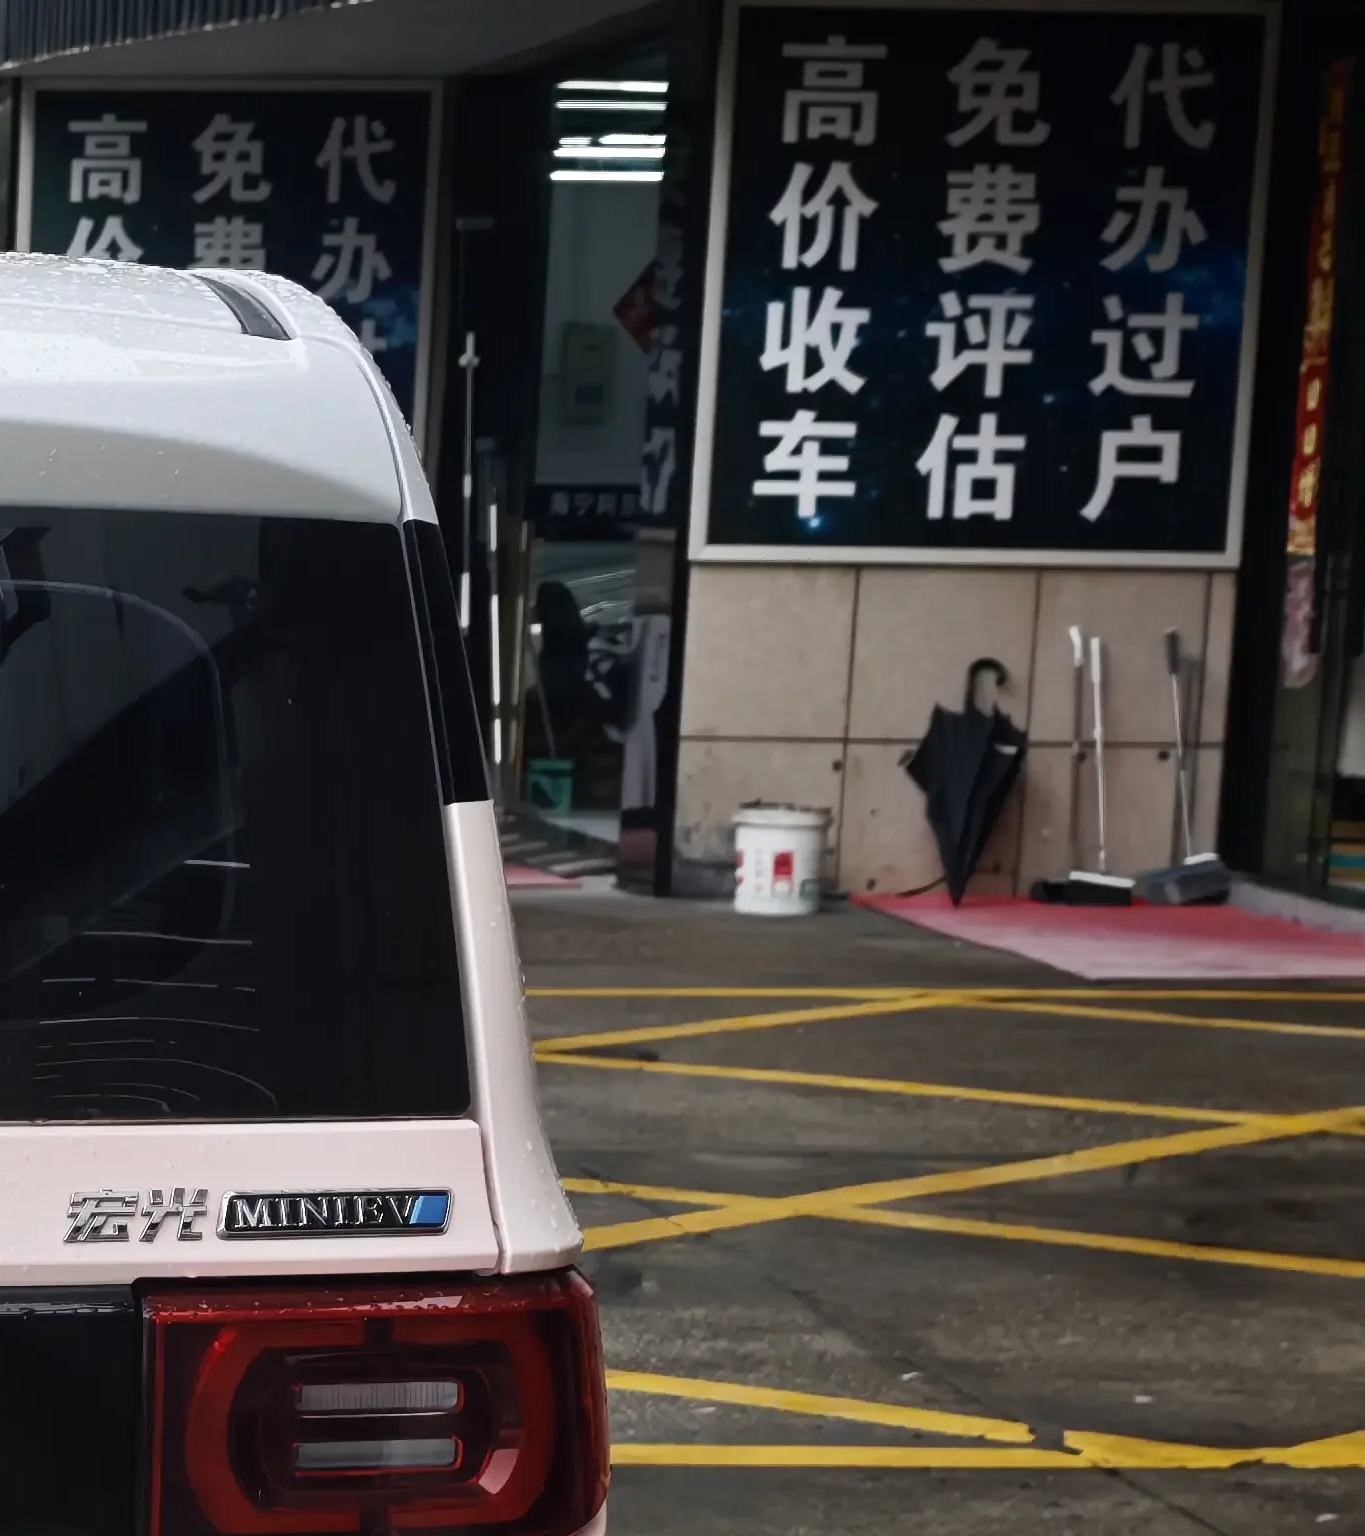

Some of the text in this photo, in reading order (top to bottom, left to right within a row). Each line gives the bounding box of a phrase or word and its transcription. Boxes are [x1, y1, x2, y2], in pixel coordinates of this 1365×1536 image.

[752, 35, 888, 519] 高价收车
[915, 37, 1051, 522] 免费评估
[1079, 42, 1216, 523] 代办过户
[62, 1187, 209, 1242] 宏光
